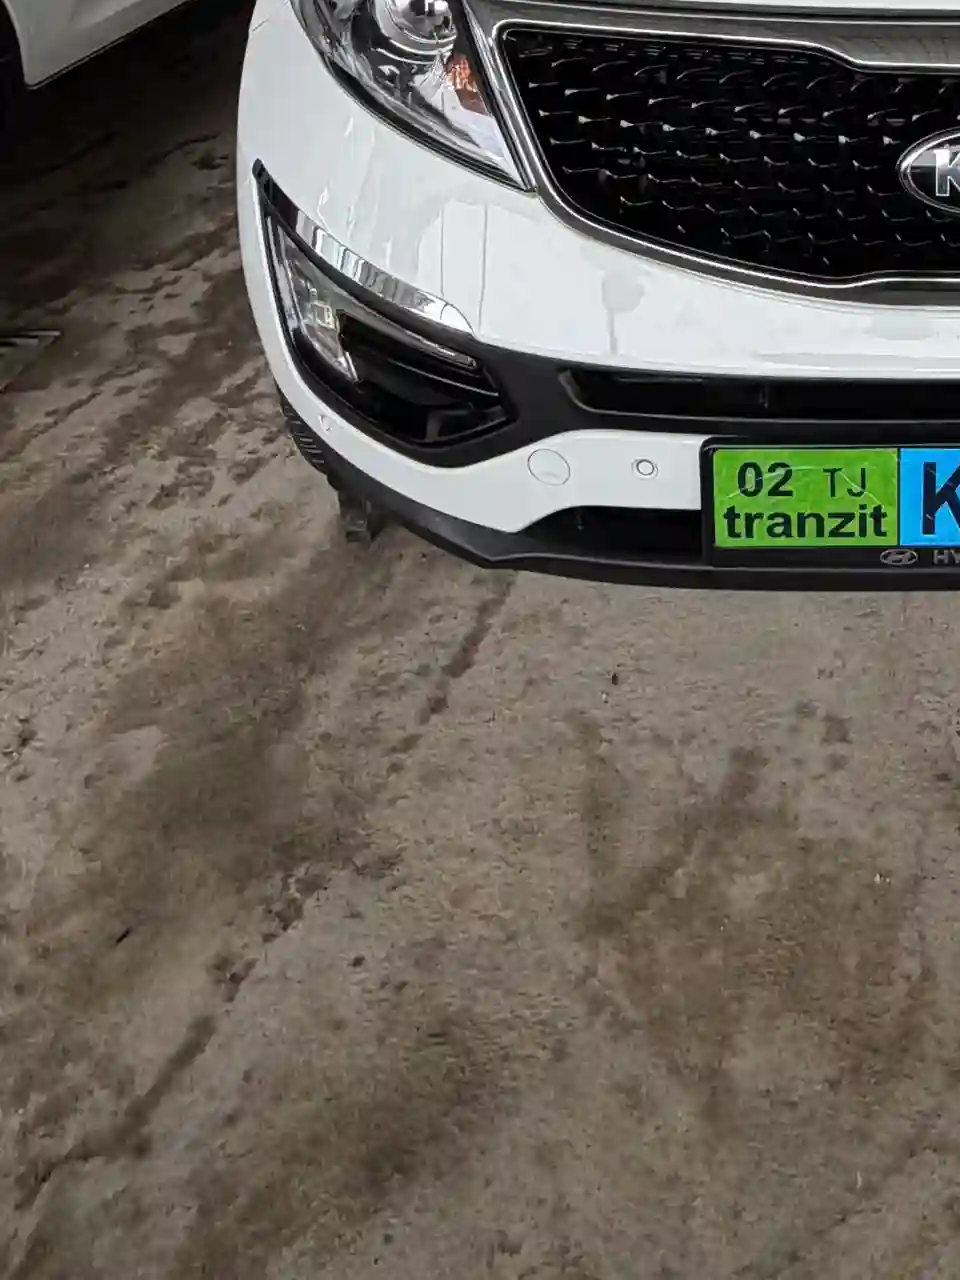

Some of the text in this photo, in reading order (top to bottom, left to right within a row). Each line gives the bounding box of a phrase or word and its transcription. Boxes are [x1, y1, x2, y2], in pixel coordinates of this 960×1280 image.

[737, 461, 867, 498] 02 TJ
[722, 503, 889, 539] tranzit
